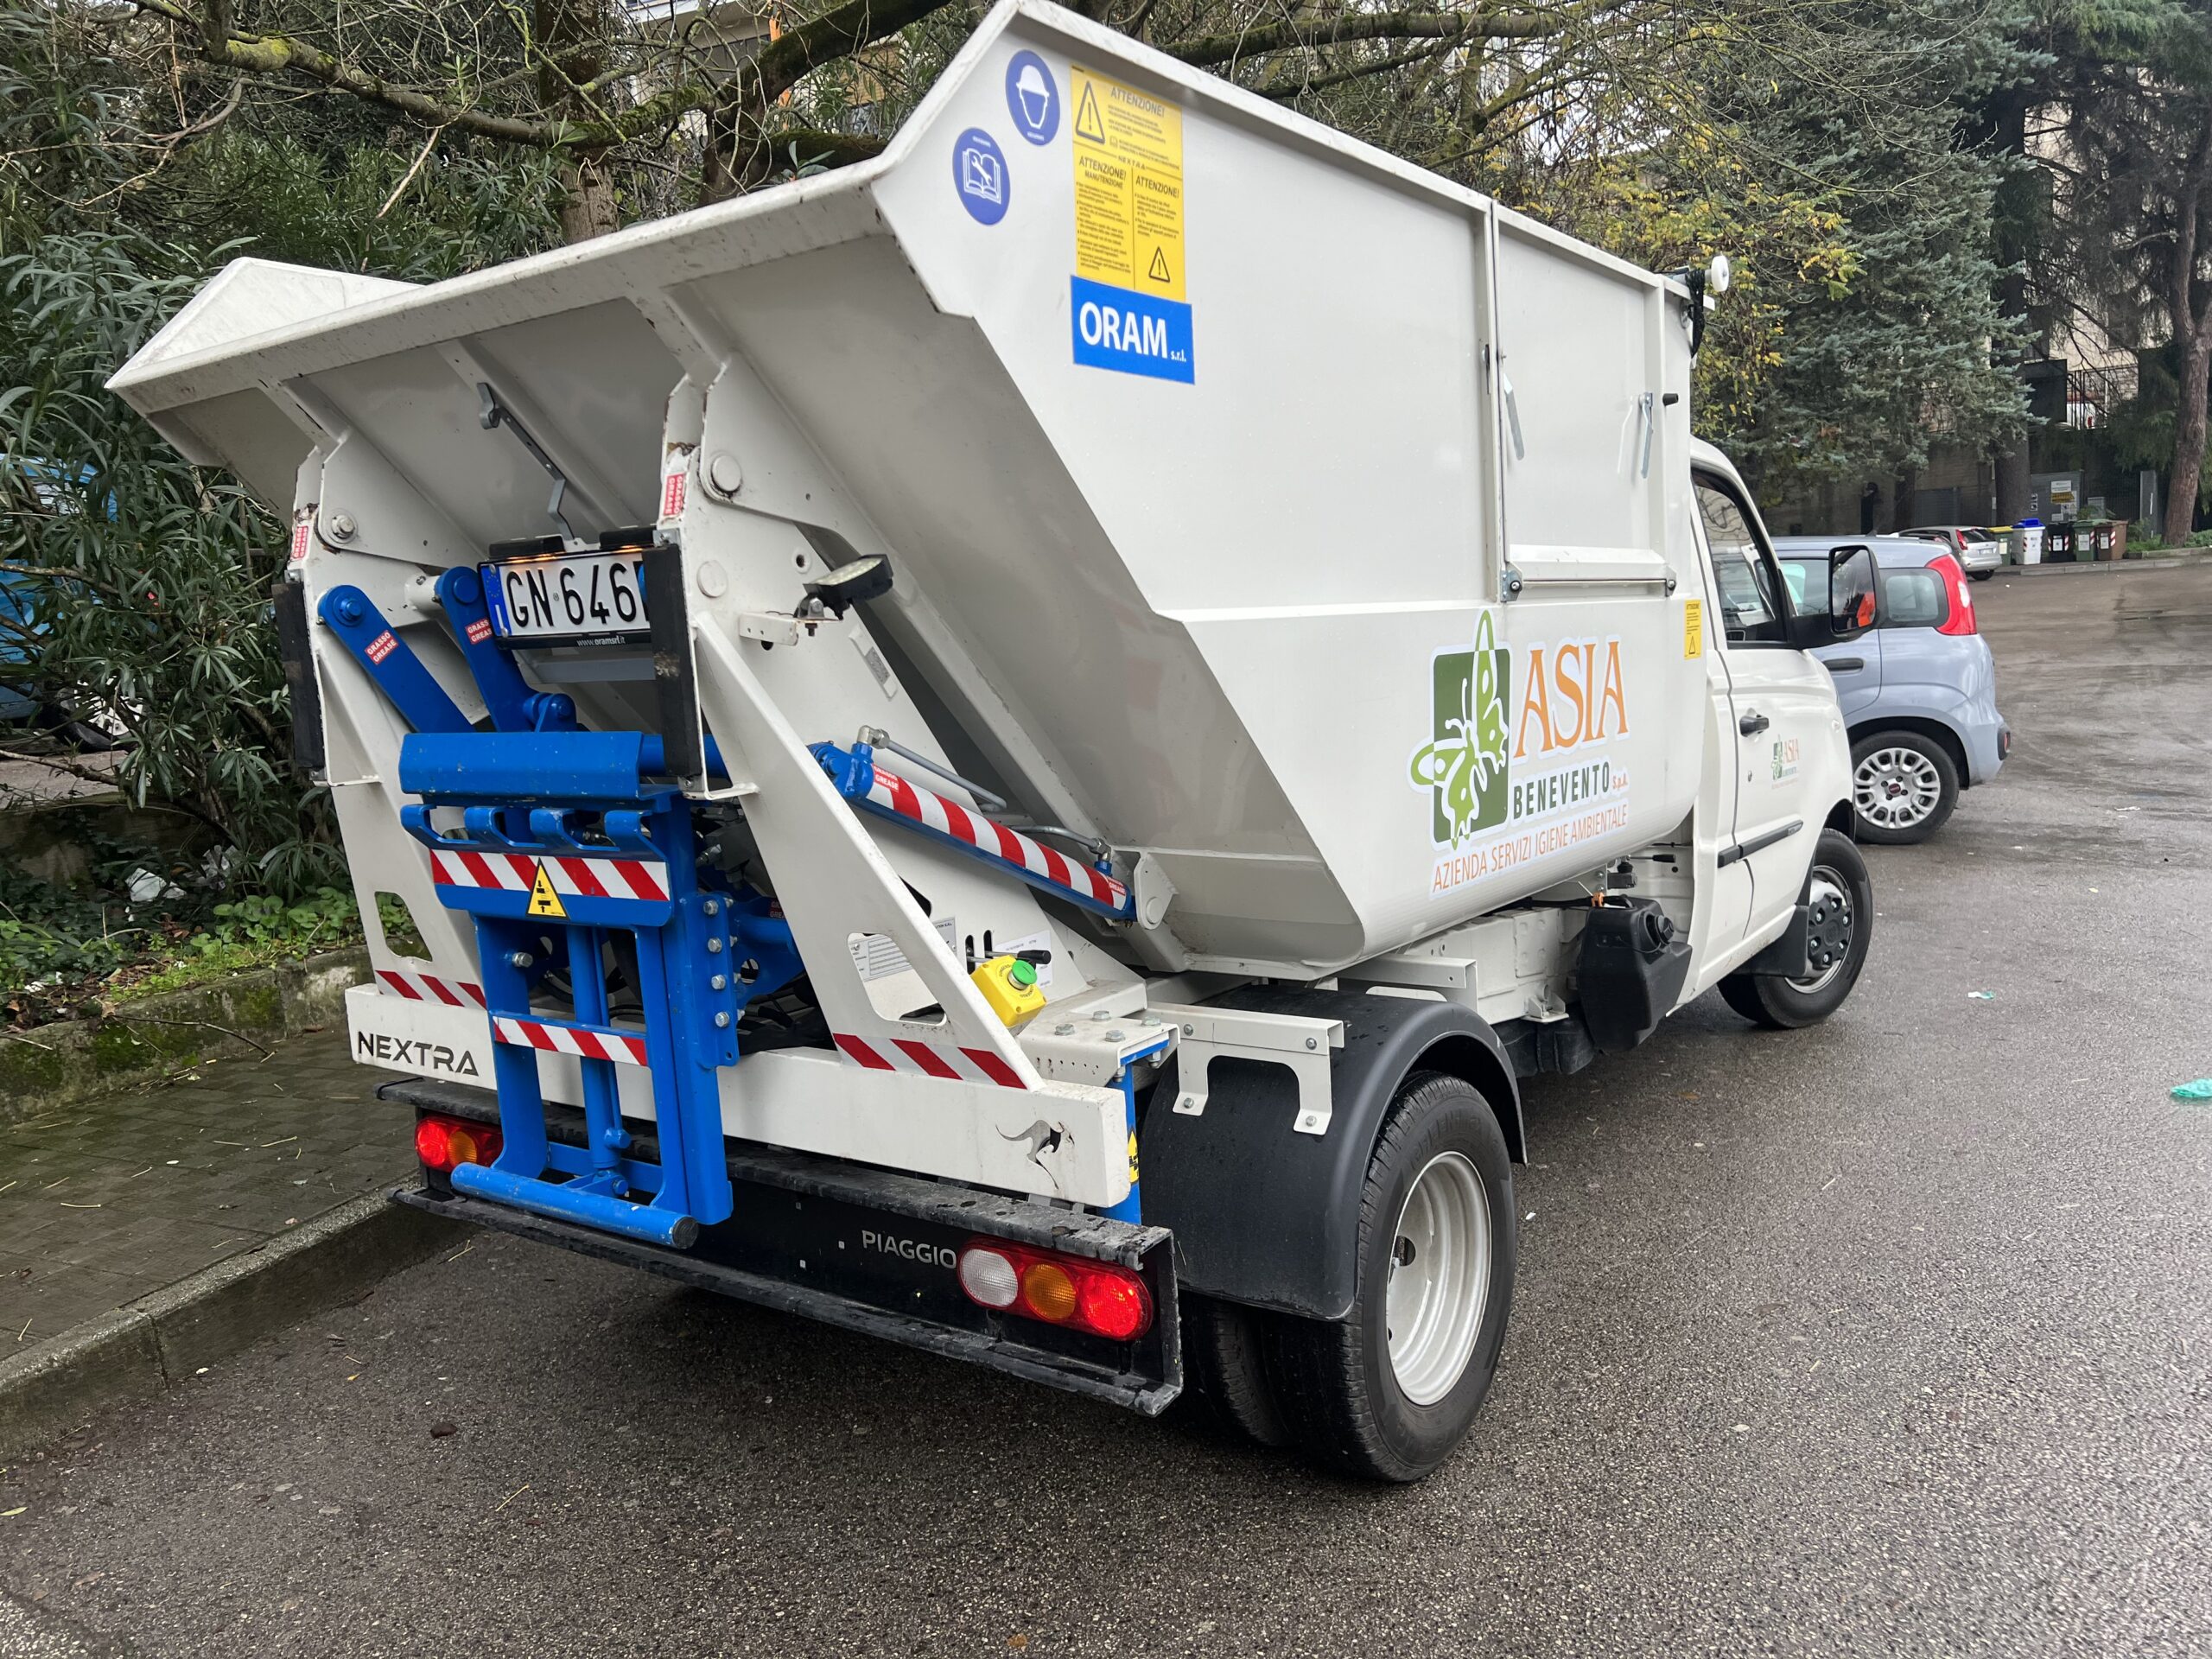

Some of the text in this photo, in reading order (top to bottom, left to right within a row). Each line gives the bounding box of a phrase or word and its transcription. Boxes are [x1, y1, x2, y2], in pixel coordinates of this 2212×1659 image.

[1110, 87, 1166, 118] ATTENZIONE!
[1079, 156, 1127, 181] ATTENZIONE!
[1084, 171, 1123, 189] MANUTENZIONE
[1135, 175, 1179, 199] ATTENZIONE!
[1079, 301, 1187, 363] ORAM s.r.l.
[560, 561, 650, 626] 646
[467, 620, 489, 633] GRASS
[471, 628, 493, 642] GREAS
[367, 632, 391, 655] GRASSO
[373, 639, 397, 662] GREASE
[576, 635, 626, 646] www.oramsrl.it
[1513, 641, 1629, 758] ASIA
[875, 773, 899, 790] GREASE
[1513, 761, 1610, 820] BENEVENTO
[1433, 804, 1627, 893] AZIENDA SERVIZI IGIENE AMBIENTALE
[358, 1031, 480, 1077] NEXTRA
[861, 1230, 957, 1269] PIAGGIO
